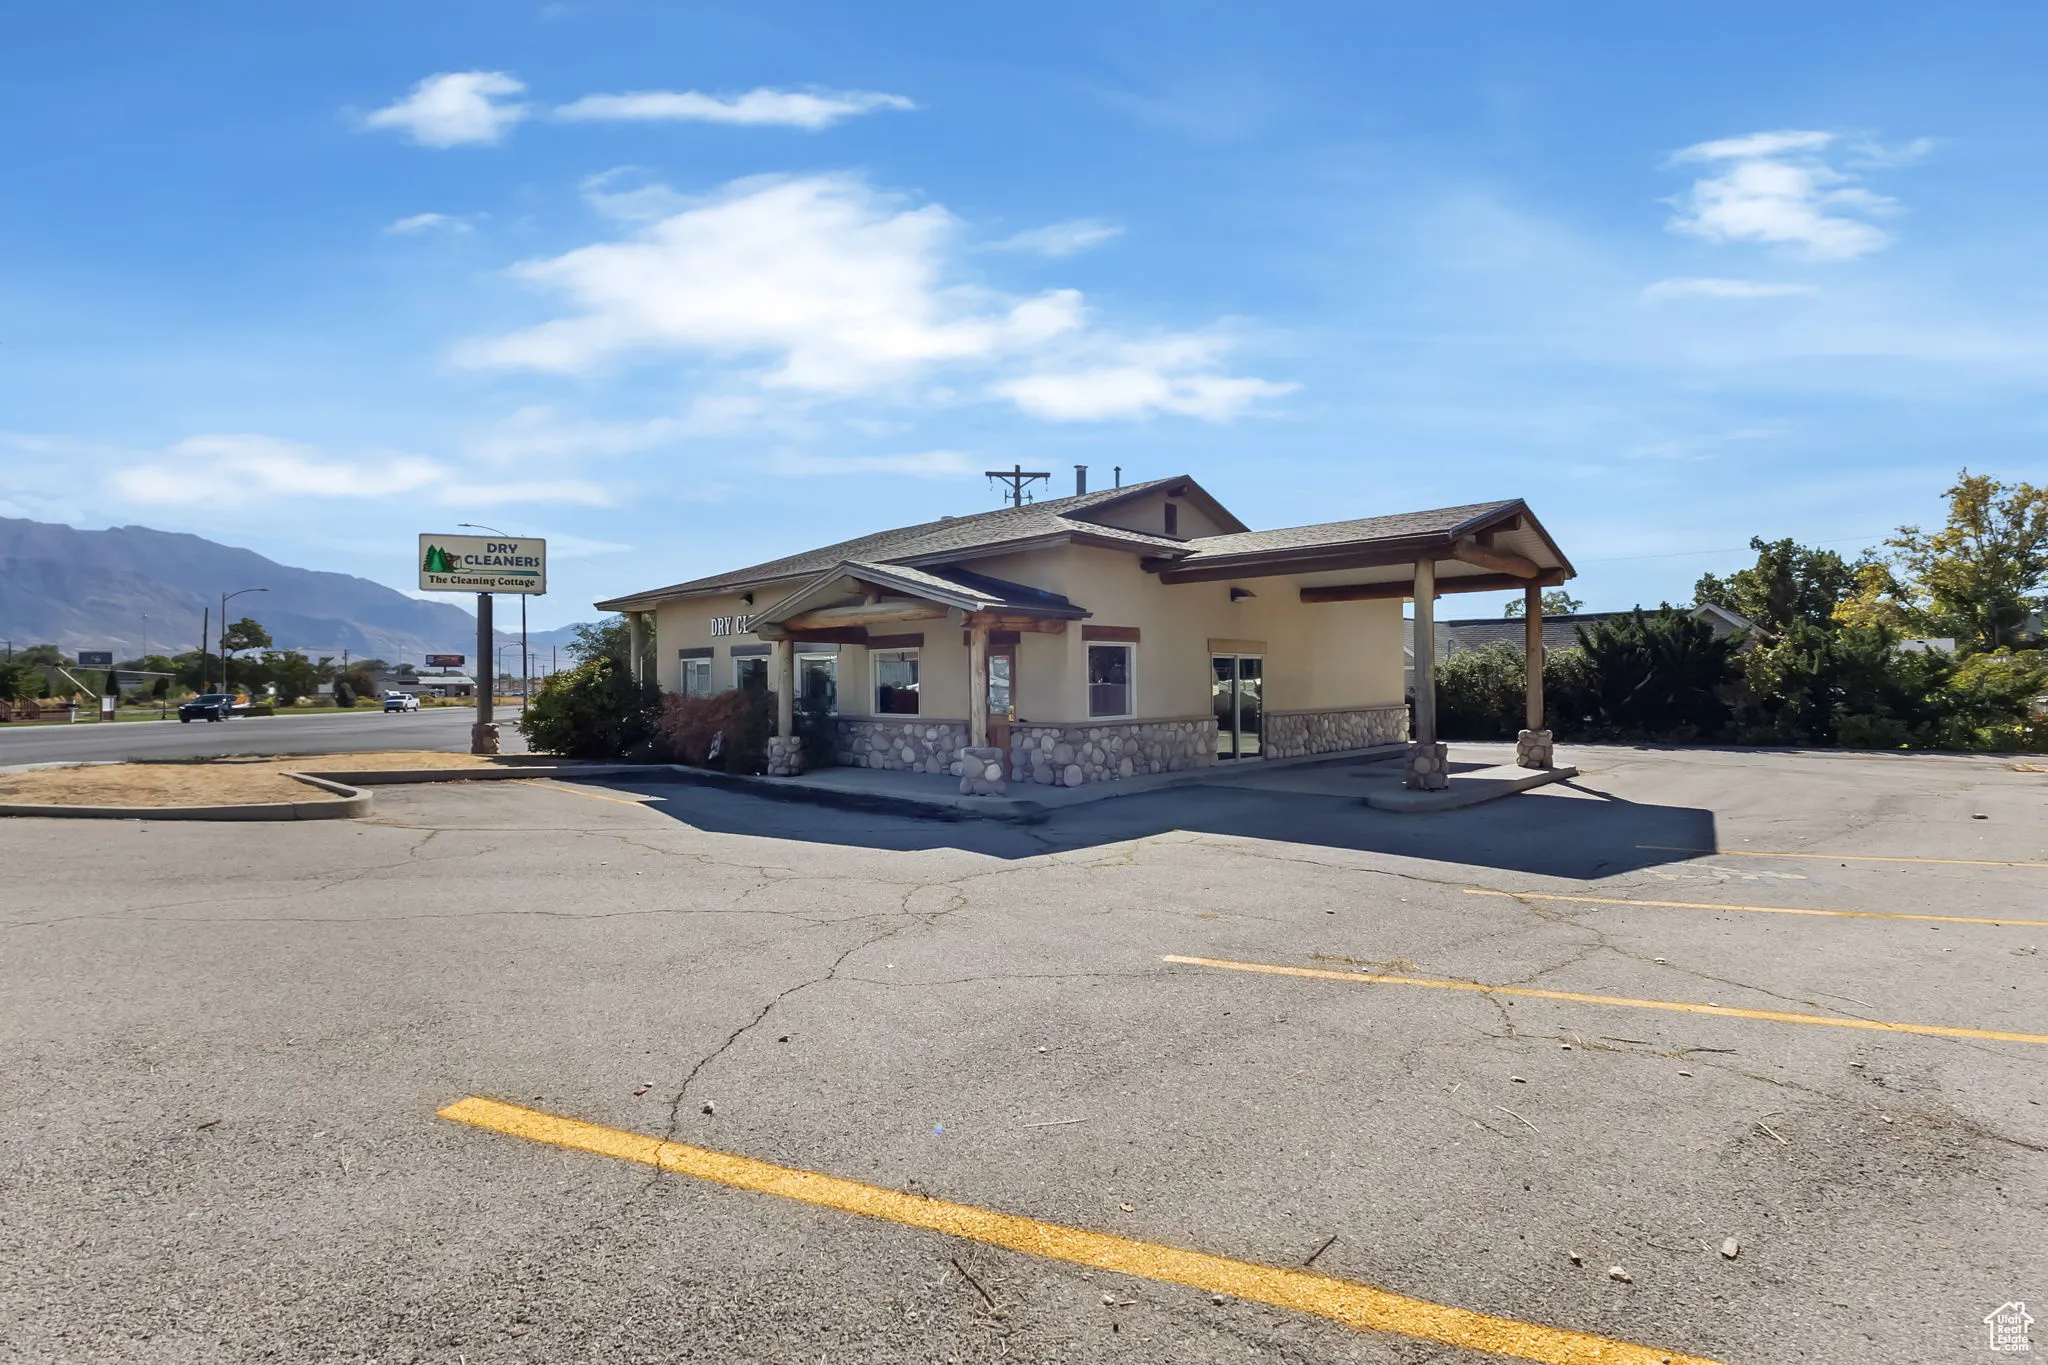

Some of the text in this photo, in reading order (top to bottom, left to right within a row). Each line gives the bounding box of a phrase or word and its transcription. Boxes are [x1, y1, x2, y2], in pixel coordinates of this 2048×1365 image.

[486, 543, 518, 554] DRY
[464, 554, 540, 567] CLEANERS
[428, 575, 536, 588] The Cleaning Cottage
[711, 614, 756, 636] DRY CL
